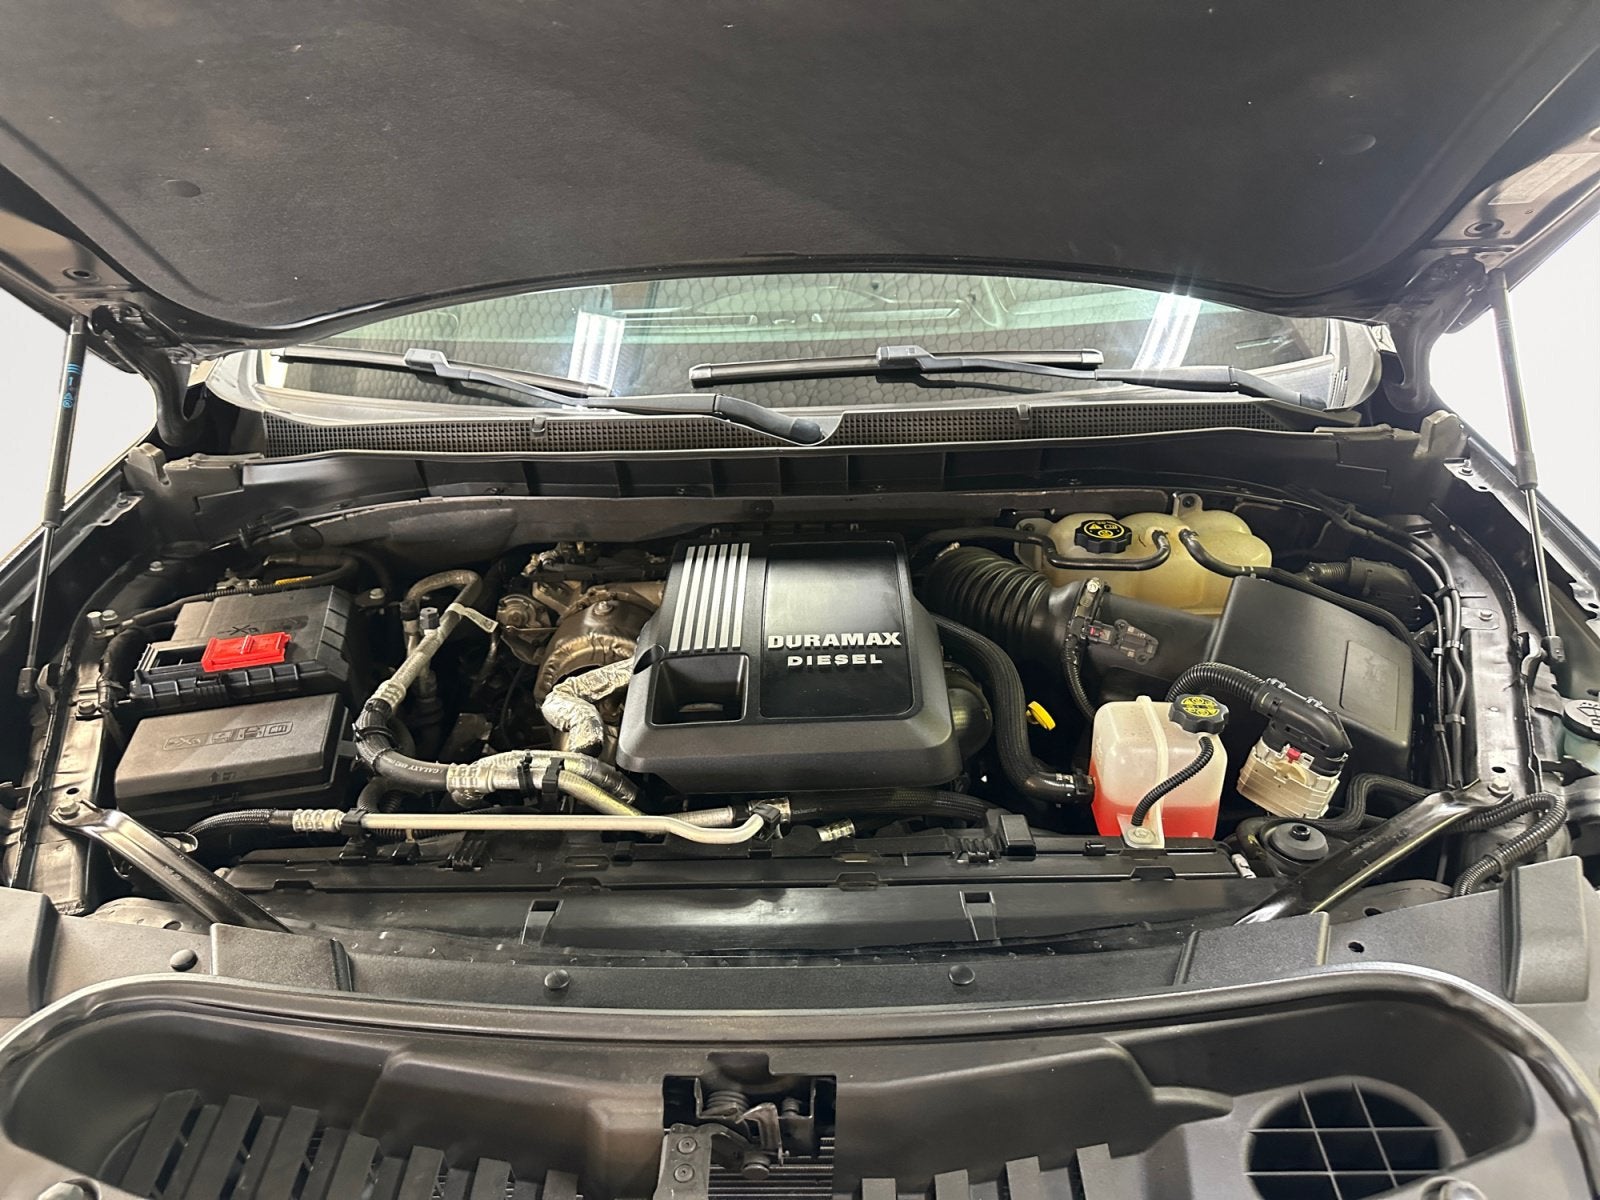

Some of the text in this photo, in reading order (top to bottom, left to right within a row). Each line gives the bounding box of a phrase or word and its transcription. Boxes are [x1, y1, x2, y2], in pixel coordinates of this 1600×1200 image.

[767, 632, 902, 649] DURAMAX
[787, 654, 883, 666] DIESEL
[408, 764, 440, 774] GALAXY
